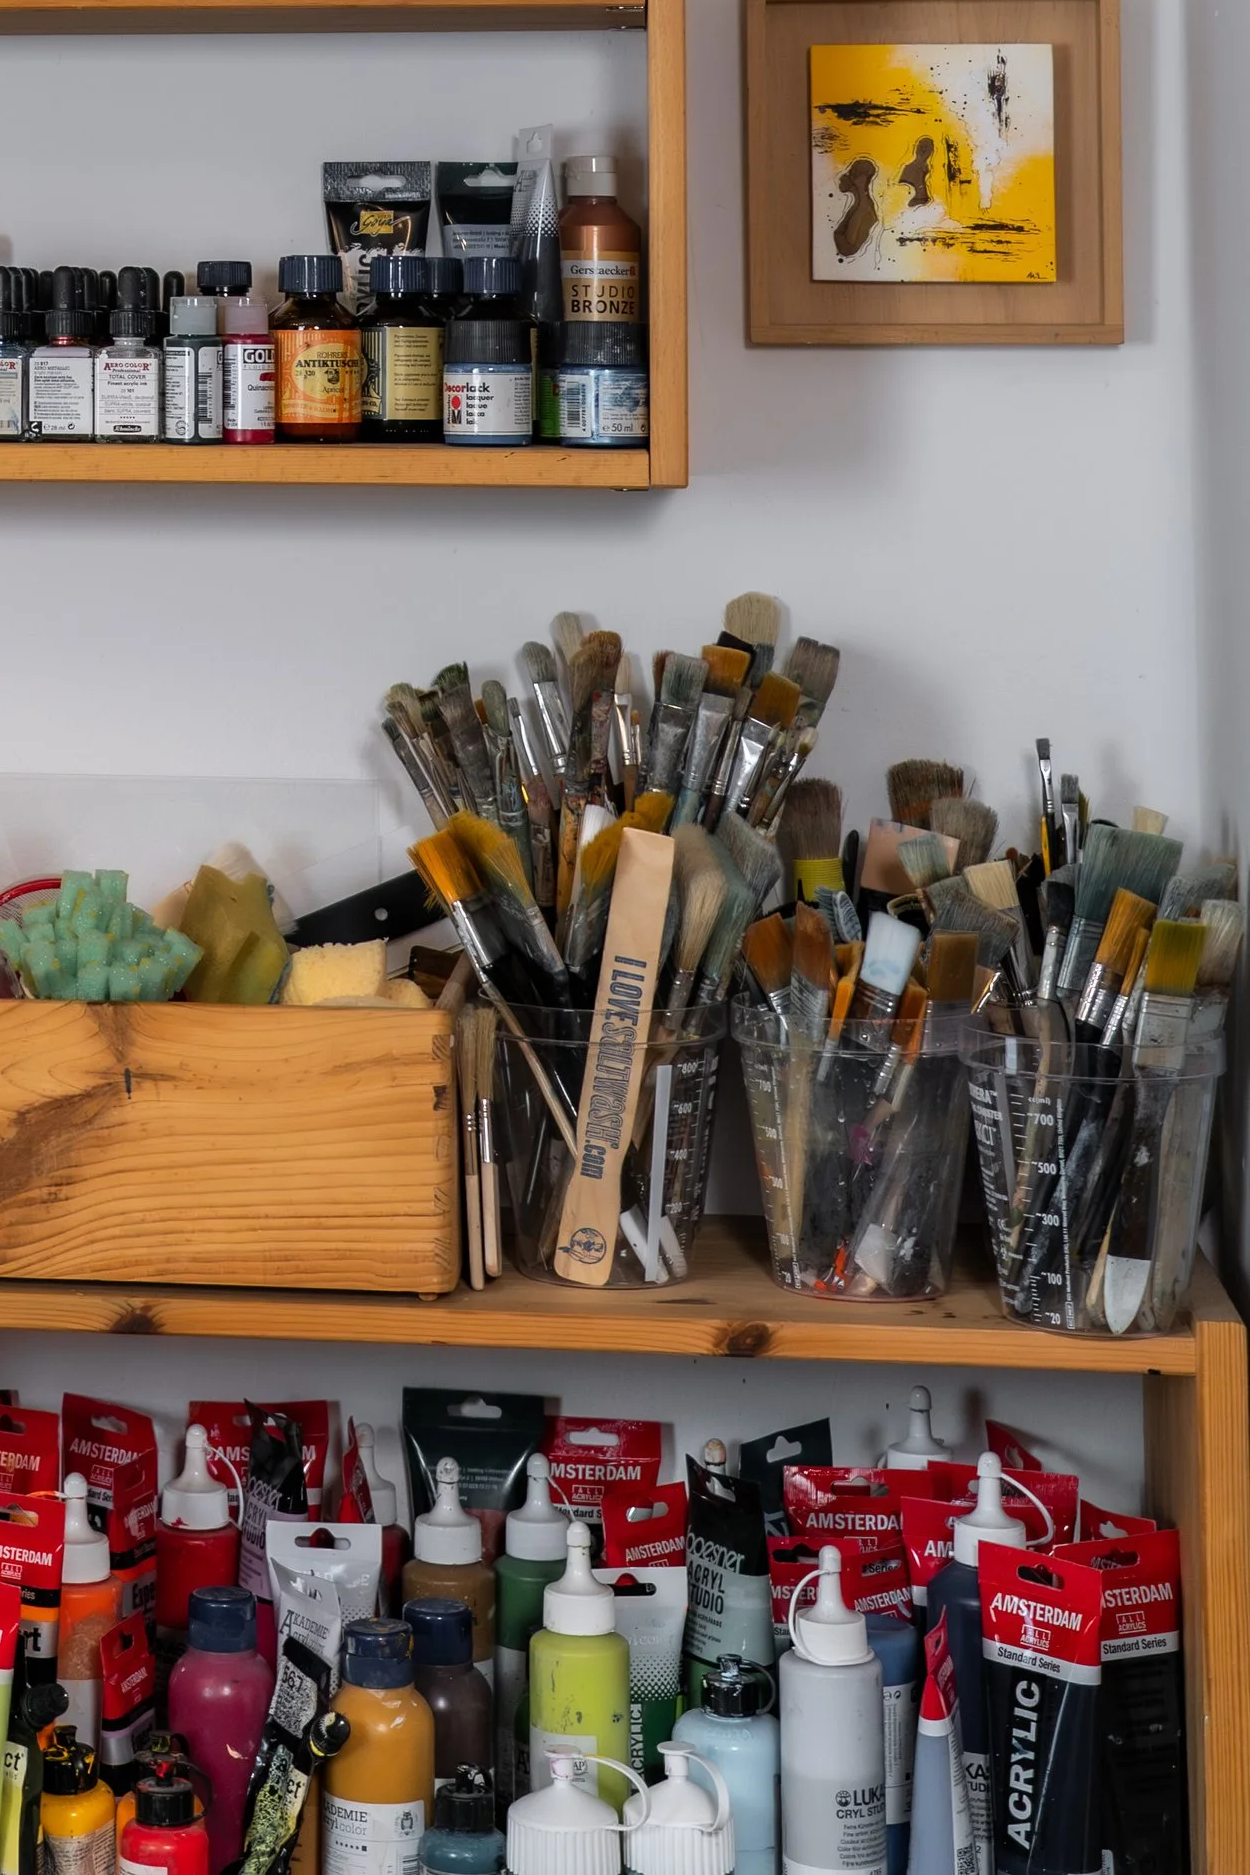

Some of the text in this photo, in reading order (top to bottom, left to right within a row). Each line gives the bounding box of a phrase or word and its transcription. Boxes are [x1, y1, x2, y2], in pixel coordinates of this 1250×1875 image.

[571, 285, 635, 298] STUDIO
[571, 299, 635, 314] BRONZE
[125, 363, 150, 371] COLOR
[611, 423, 634, 432] 50 ml
[614, 955, 648, 969] I
[605, 969, 645, 1026] LOVE
[550, 1463, 641, 1481] MSTERDAM
[806, 1513, 900, 1530] AMSTERDA
[625, 1536, 686, 1562] AMSTERDAM
[1101, 1582, 1174, 1609] STERDAM
[991, 1591, 1083, 1632] AMSTERDAM
[279, 1609, 329, 1640] AKADEMIE
[1103, 1636, 1167, 1656] Standard Series
[997, 1646, 1060, 1674] Standard Series
[1007, 1680, 1041, 1850] ACRYLIC
[836, 1809, 865, 1819] CRYL
